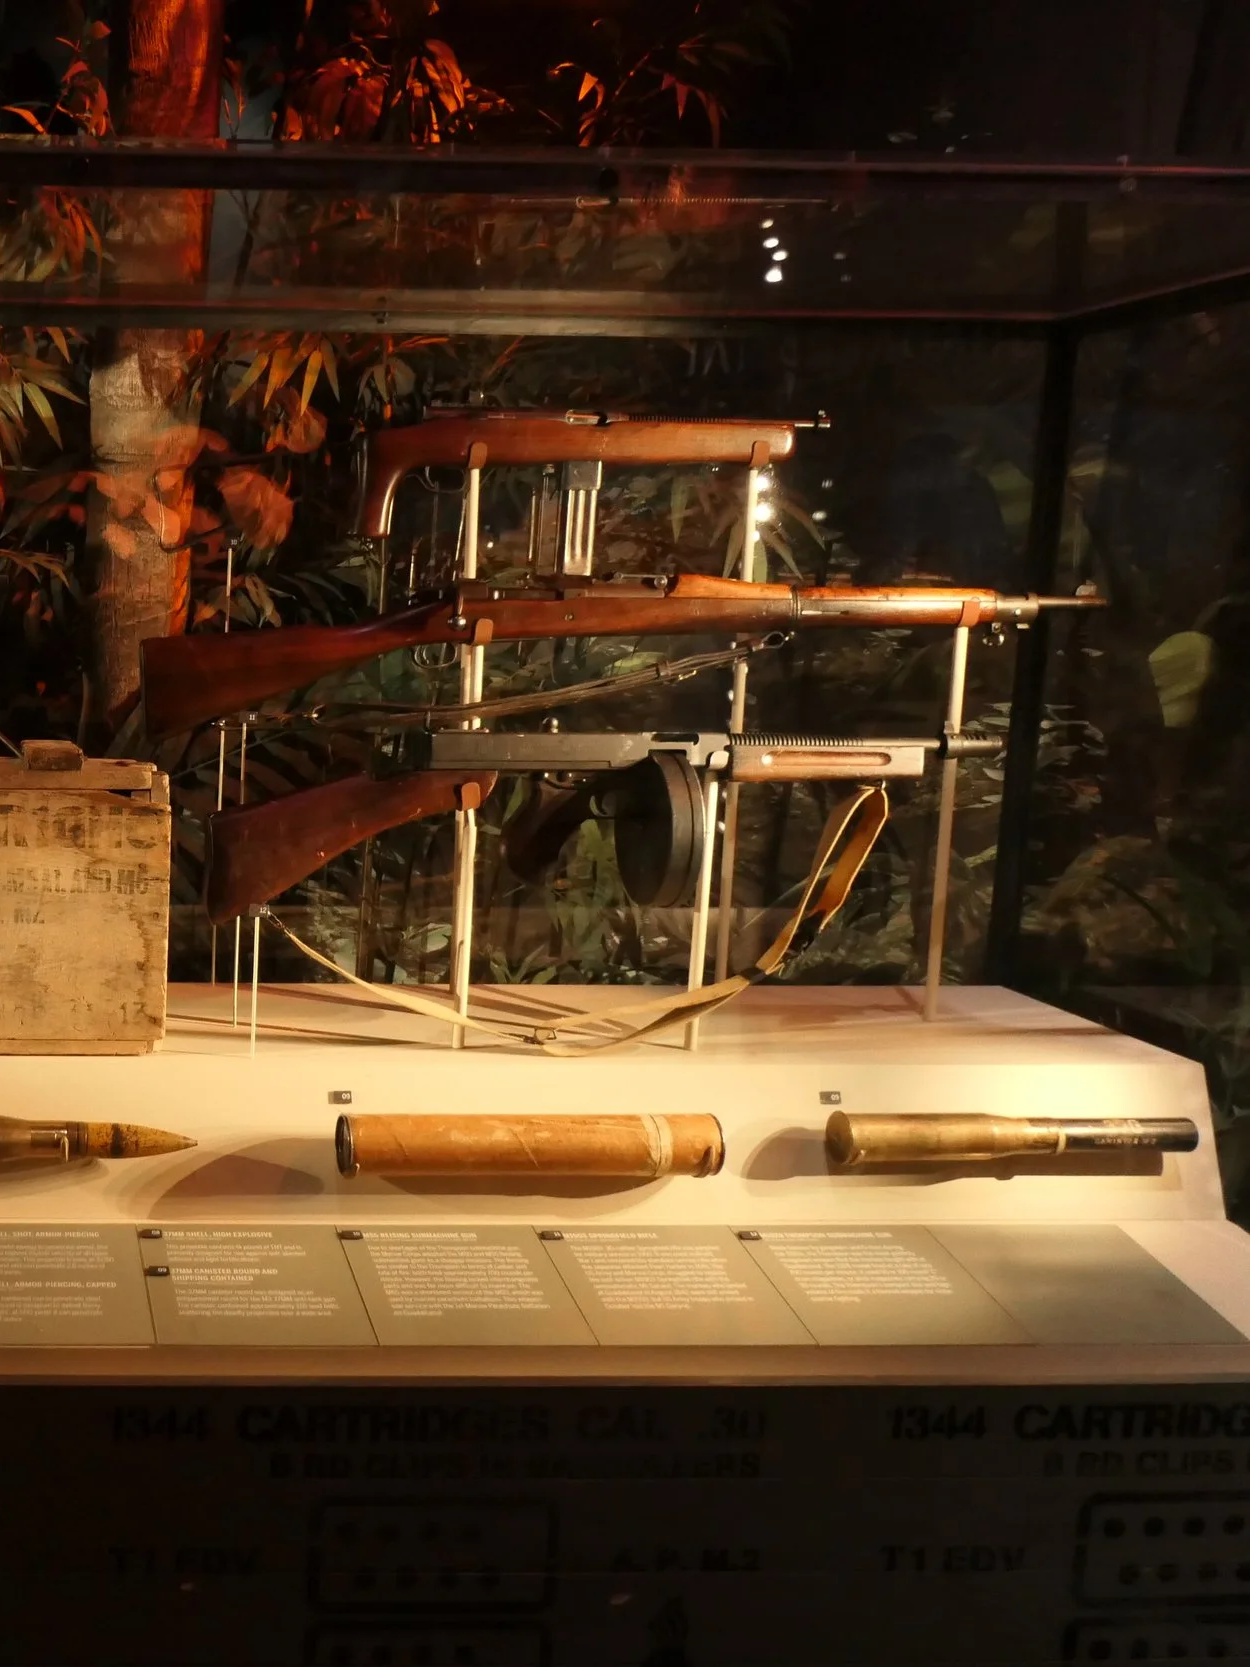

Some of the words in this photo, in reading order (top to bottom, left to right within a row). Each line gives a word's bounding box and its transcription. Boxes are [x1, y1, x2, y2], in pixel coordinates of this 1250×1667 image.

[110, 1404, 210, 1442] 1344
[237, 1404, 550, 1443] CARTRIDGES
[887, 1404, 988, 1441] 1344
[1135, 1449, 1235, 1475] CLIPS
[943, 1545, 1026, 1572] EDV
